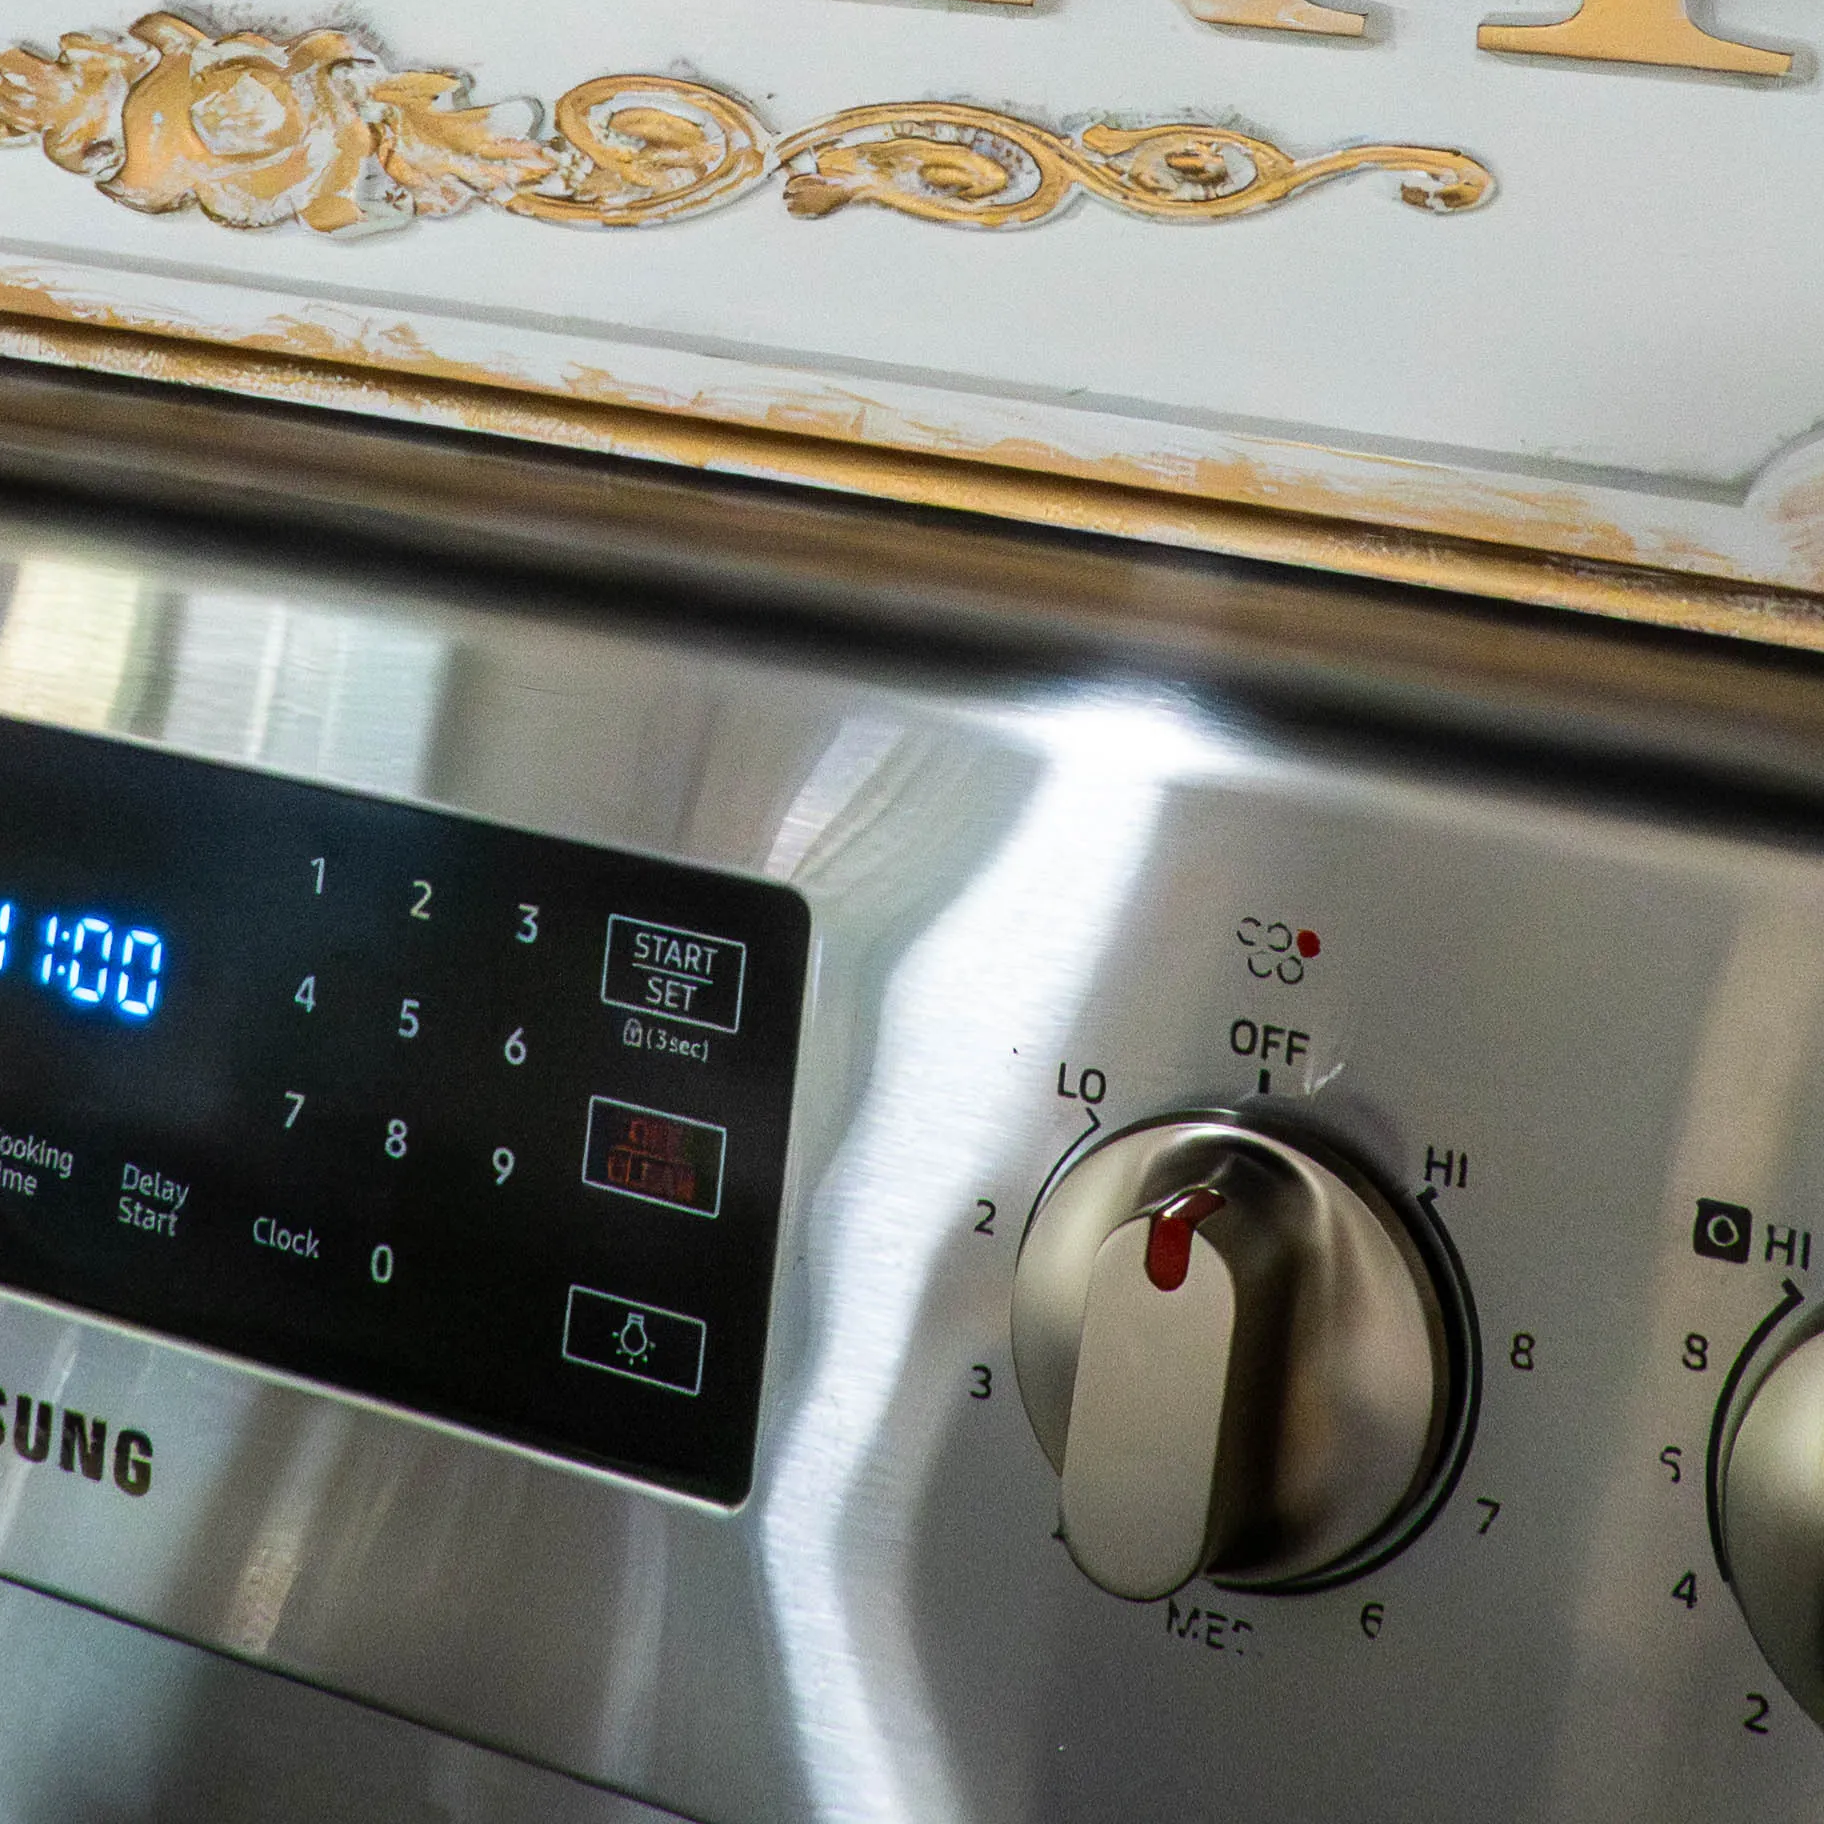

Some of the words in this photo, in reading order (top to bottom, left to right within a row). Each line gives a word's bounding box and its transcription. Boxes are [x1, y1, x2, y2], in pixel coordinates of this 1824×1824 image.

[310, 856, 326, 894] 1
[410, 880, 432, 920] 2
[515, 904, 540, 944] 3
[633, 932, 719, 977] START
[294, 975, 317, 1013] 4
[644, 976, 699, 1012] SET
[397, 999, 421, 1039] 5
[503, 1027, 527, 1066] 6
[1229, 1018, 1311, 1066] OFF
[1057, 1062, 1107, 1105] LO
[284, 1090, 306, 1129] 7
[384, 1119, 408, 1159] 8
[121, 1162, 190, 1209] Delay
[491, 1147, 516, 1186] 9
[1423, 1144, 1468, 1189] HI
[117, 1196, 178, 1237] Start
[974, 1198, 997, 1236] 2
[252, 1216, 320, 1260] Clock
[1764, 1224, 1812, 1270] HI
[371, 1244, 394, 1283] 0
[1510, 1332, 1536, 1371] 8
[969, 1363, 993, 1401] 3
[1476, 1497, 1502, 1536] 7
[1672, 1571, 1699, 1610] 4
[1743, 1692, 1770, 1734] 2
